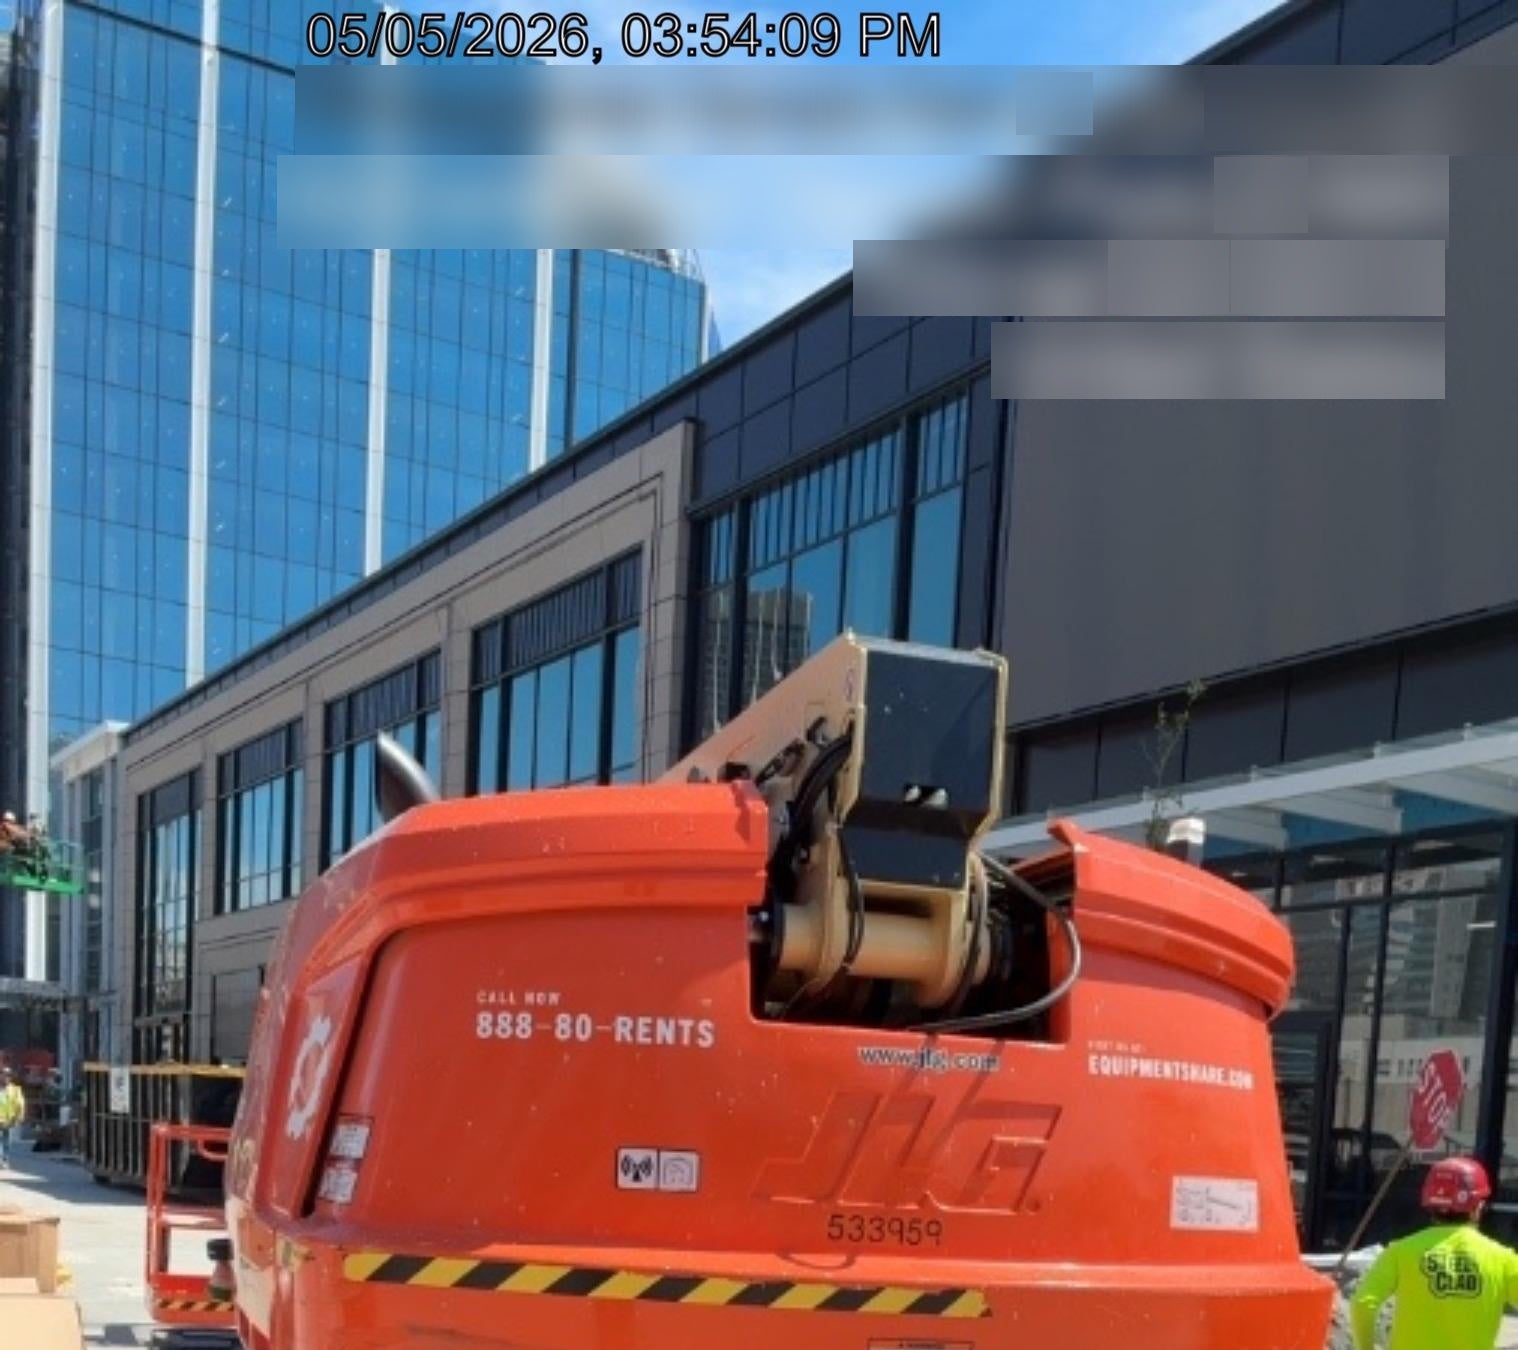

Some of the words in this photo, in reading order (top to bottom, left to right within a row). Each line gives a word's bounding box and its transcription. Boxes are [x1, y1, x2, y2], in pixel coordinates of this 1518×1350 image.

[476, 1011, 716, 1048] 888-80-RENTS
[1088, 1054, 1255, 1090] EQUIPMENTSHARE.COM
[826, 1213, 943, 1246] 533959
[1435, 1271, 1478, 1291] CLAD
